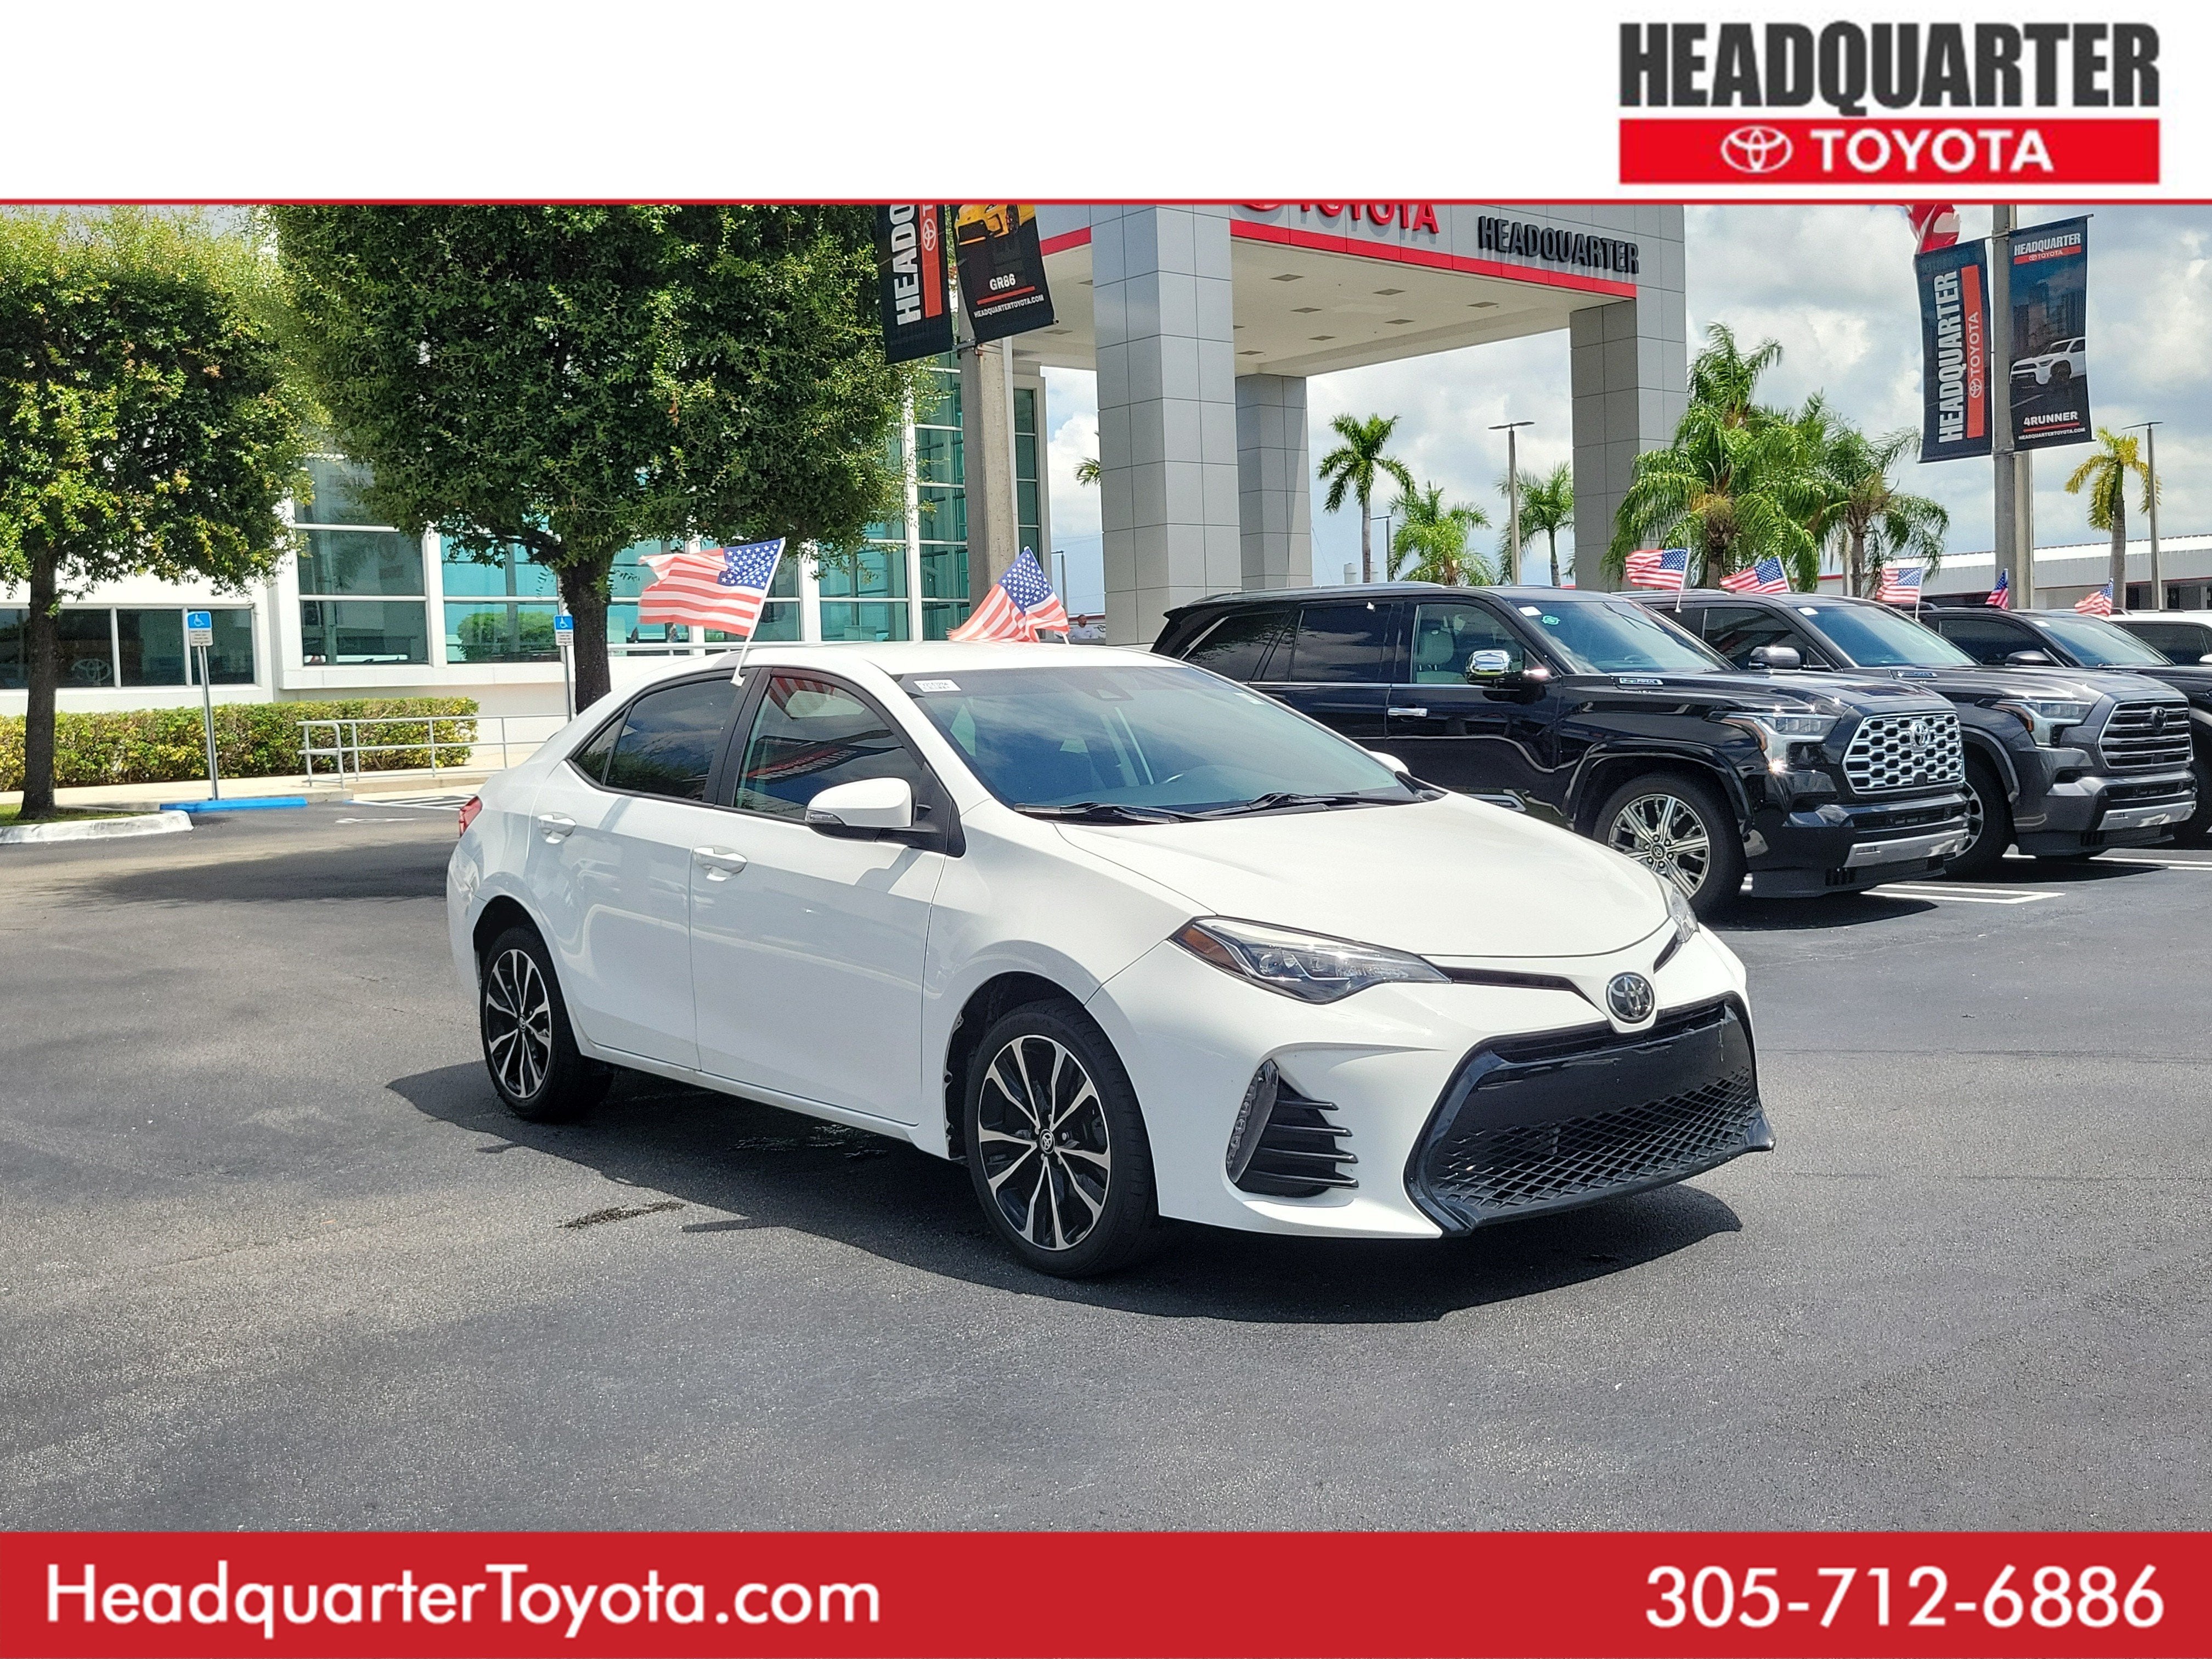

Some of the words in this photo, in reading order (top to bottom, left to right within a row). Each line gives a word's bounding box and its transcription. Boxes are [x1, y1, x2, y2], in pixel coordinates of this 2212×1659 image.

[1478, 216, 1639, 274] HEADQUARTER
[2014, 233, 2081, 256] HEADQUARTER
[2037, 250, 2063, 259] TOYOTA
[989, 273, 1016, 291] GR86
[973, 294, 1045, 318] HEADQUARTERTOYOTA.COM
[1968, 312, 1980, 377] TOYOTA
[1933, 270, 1967, 443] HEADQUARTER
[2023, 411, 2078, 426] 4RUNNER
[2018, 427, 2086, 441] HEADQUARTERTOYOTA.COM
